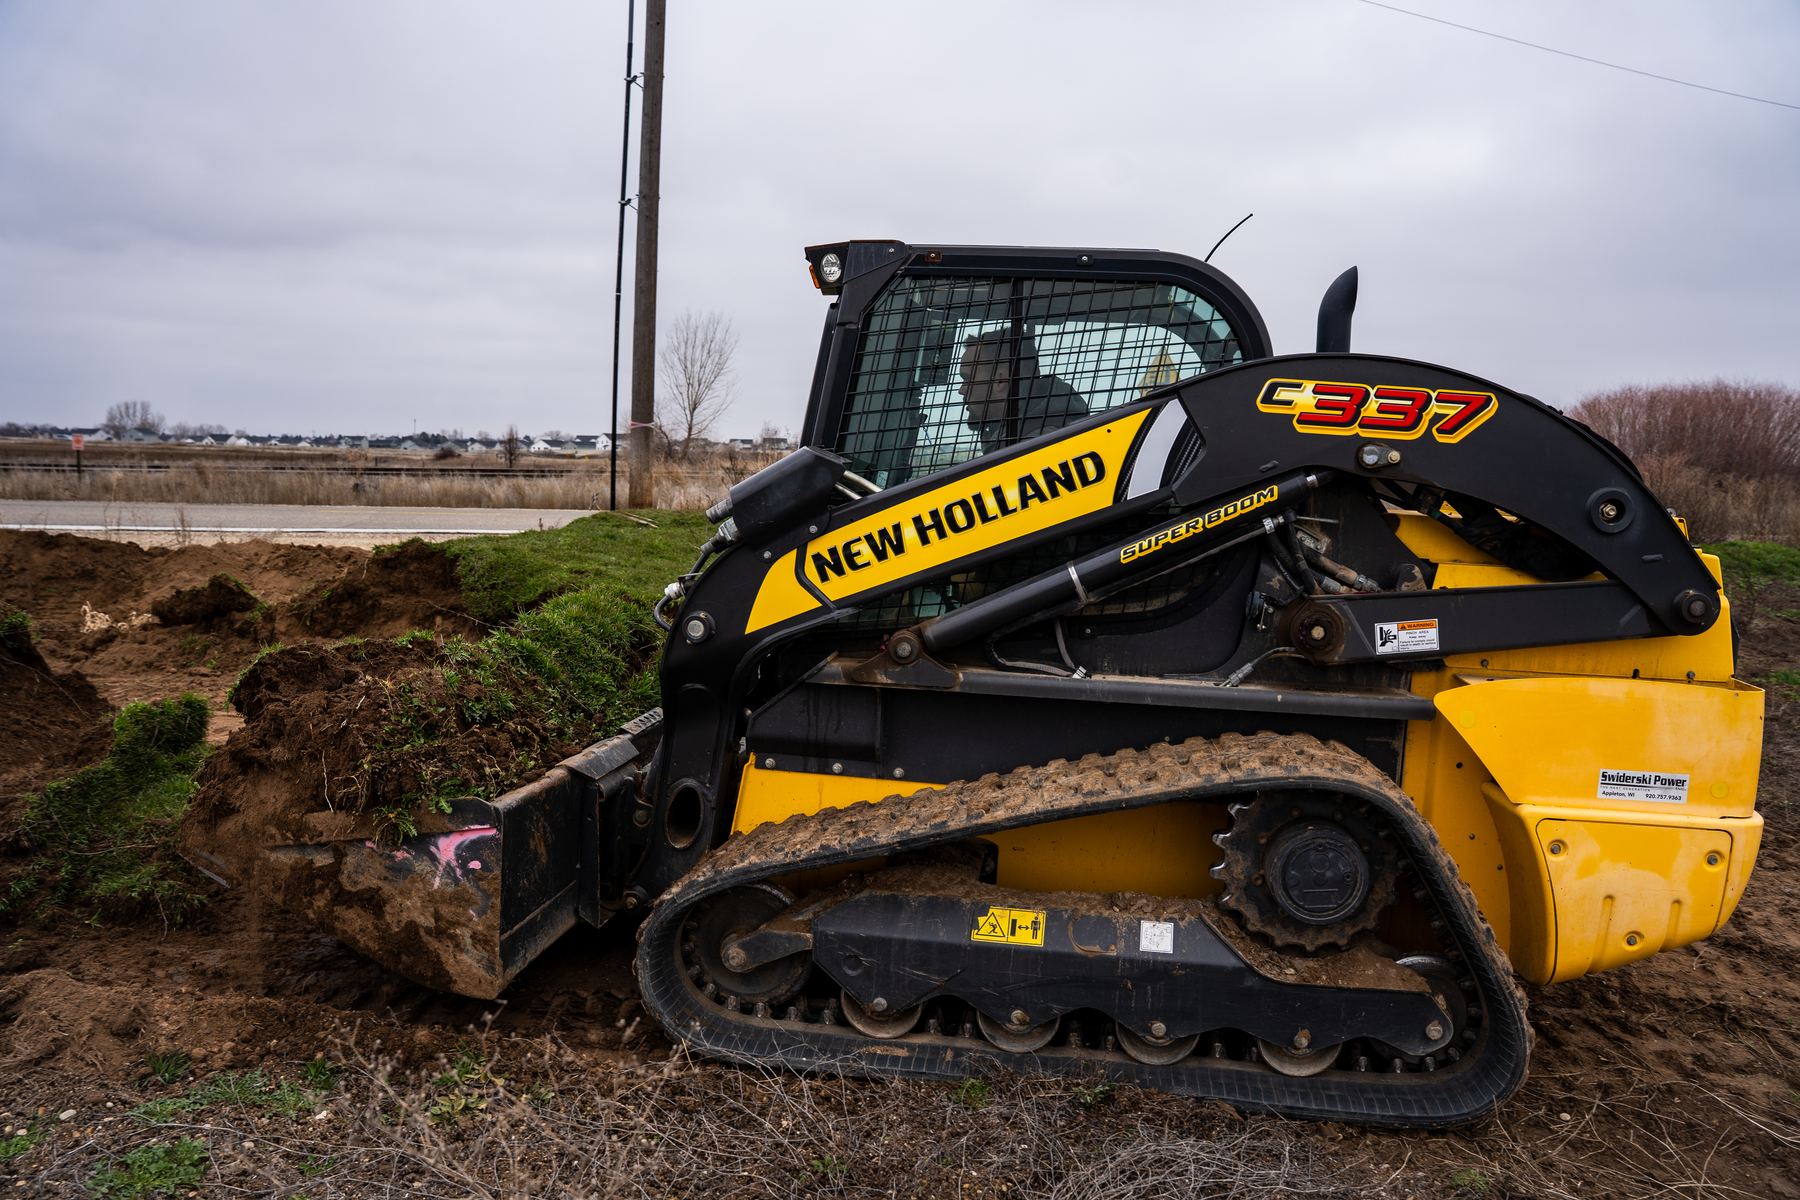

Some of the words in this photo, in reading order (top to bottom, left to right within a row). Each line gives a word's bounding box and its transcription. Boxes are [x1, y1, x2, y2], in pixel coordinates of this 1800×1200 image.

[1257, 378, 1498, 443] C337
[810, 520, 906, 583] NEW
[911, 450, 1106, 547] HOLLAND
[1120, 517, 1204, 564] SUPER
[1205, 485, 1278, 528] BOOM
[1601, 771, 1652, 785] Swiderski
[1653, 775, 1687, 787] Power
[1645, 793, 1682, 801] 920.757.9363
